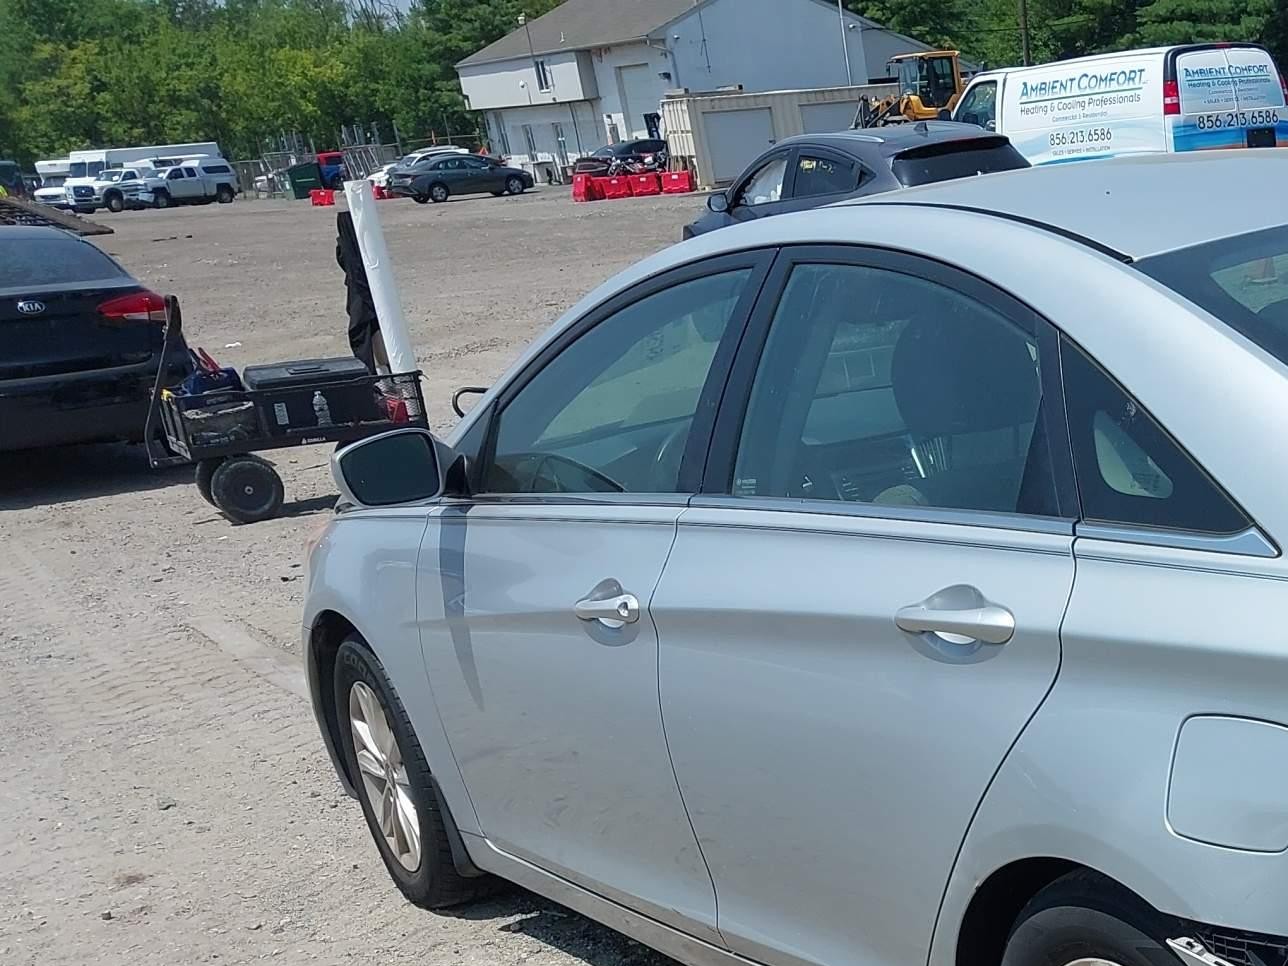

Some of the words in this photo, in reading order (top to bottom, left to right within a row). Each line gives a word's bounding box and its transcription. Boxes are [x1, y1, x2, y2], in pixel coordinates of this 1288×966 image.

[1184, 67, 1226, 78] AMBIENT
[1228, 64, 1269, 75] COMFORT
[1020, 78, 1076, 99] AMBIENT
[1077, 69, 1145, 91] COMFORT
[1188, 81, 1211, 89] Heating
[1020, 104, 1048, 116] Heating
[1049, 102, 1055, 112] &
[1057, 99, 1086, 111] Cooling
[1088, 93, 1141, 109] Professionals
[1198, 110, 1279, 129] 856.213.6586
[1049, 128, 1112, 146] 856.213.6586
